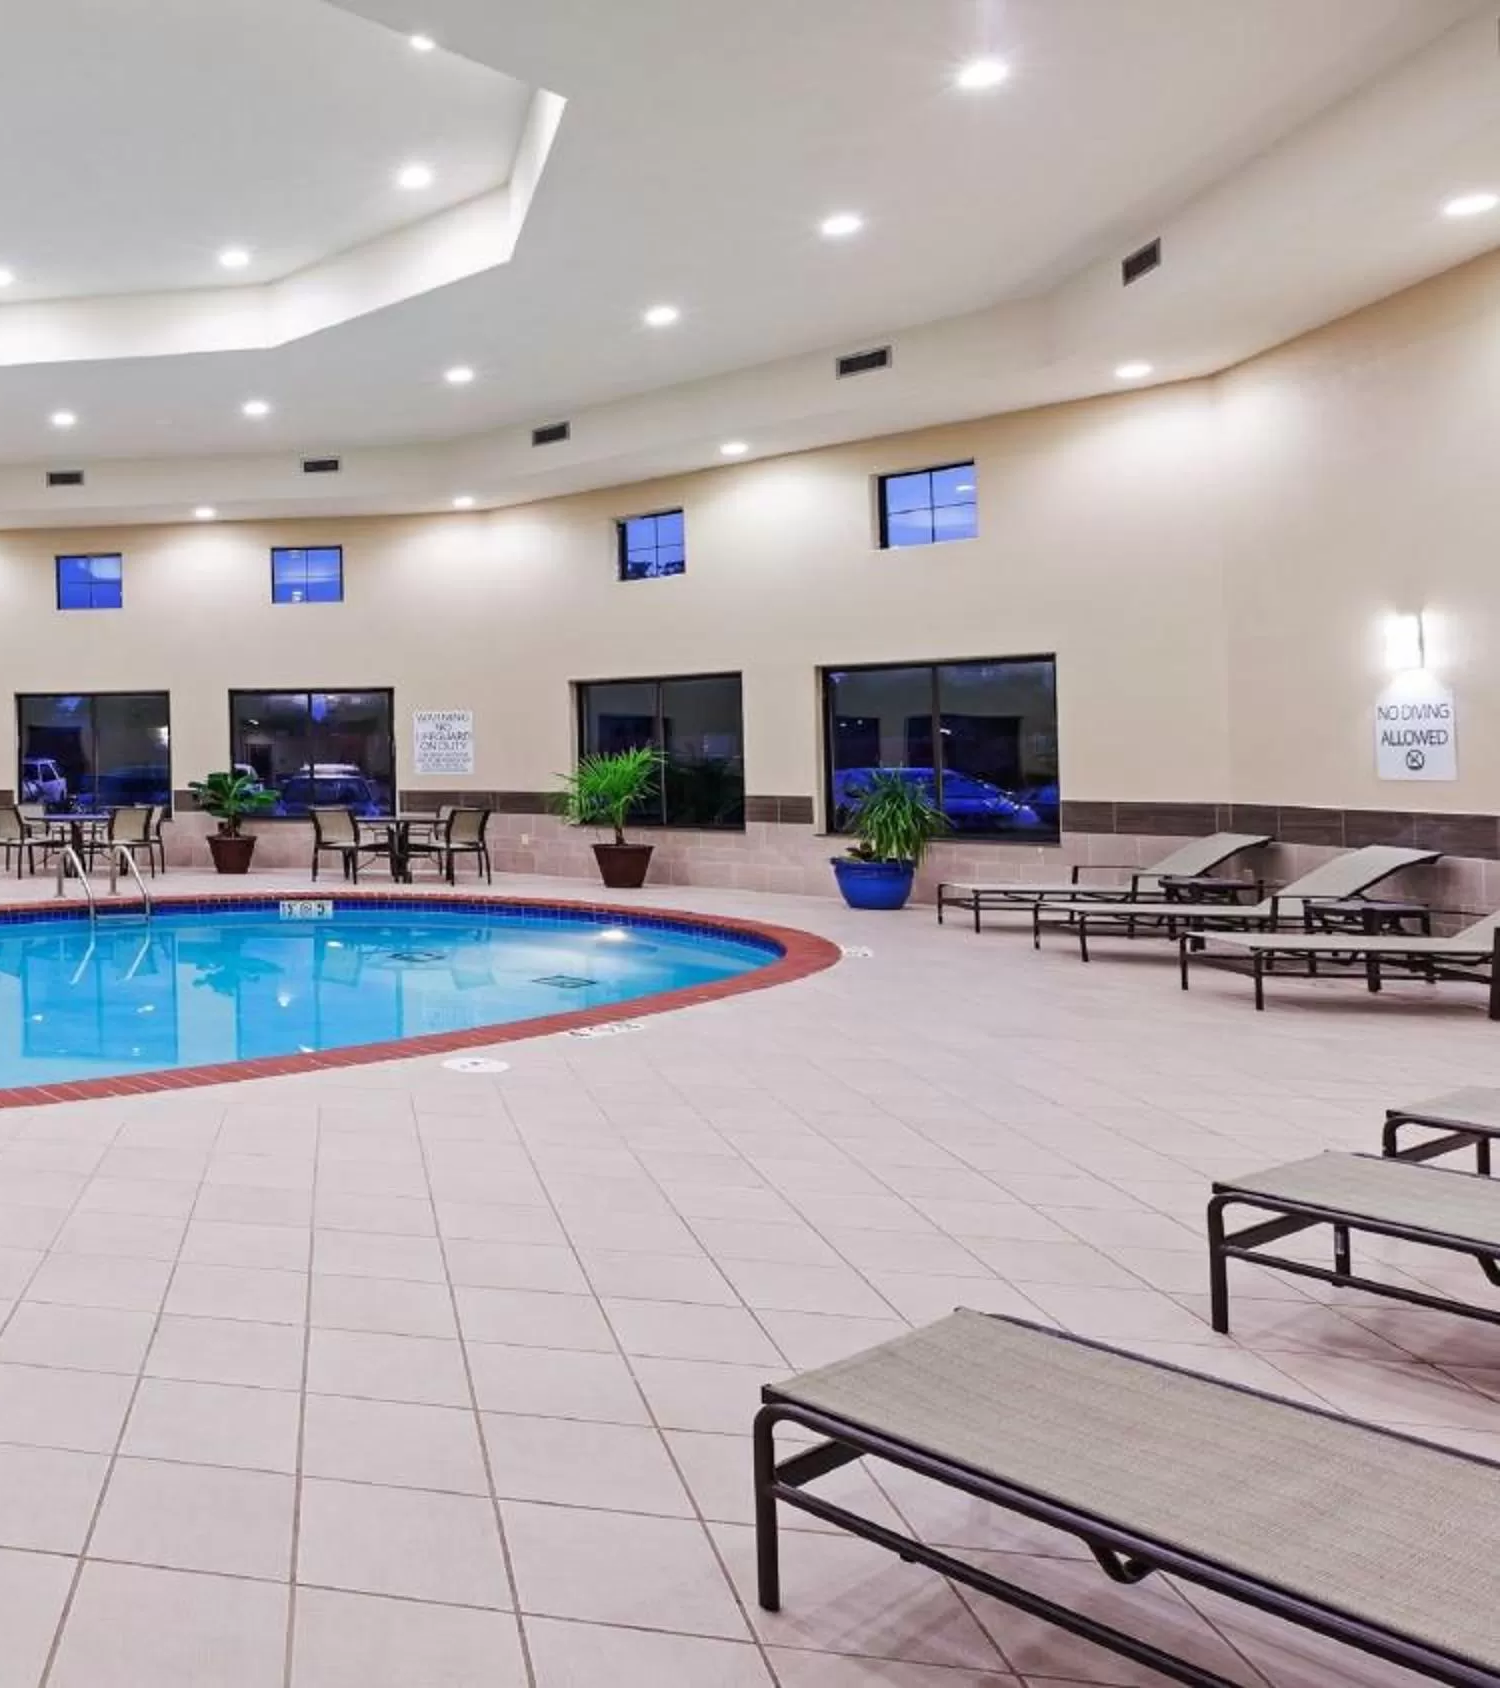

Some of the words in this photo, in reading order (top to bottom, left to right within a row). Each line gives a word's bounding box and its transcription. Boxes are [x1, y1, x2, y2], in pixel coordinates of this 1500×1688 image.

[1377, 705, 1399, 720] NO
[1402, 703, 1450, 720] DIVING
[419, 741, 436, 750] ON
[438, 741, 468, 750] DUTY
[1381, 729, 1449, 746] ALLOWED
